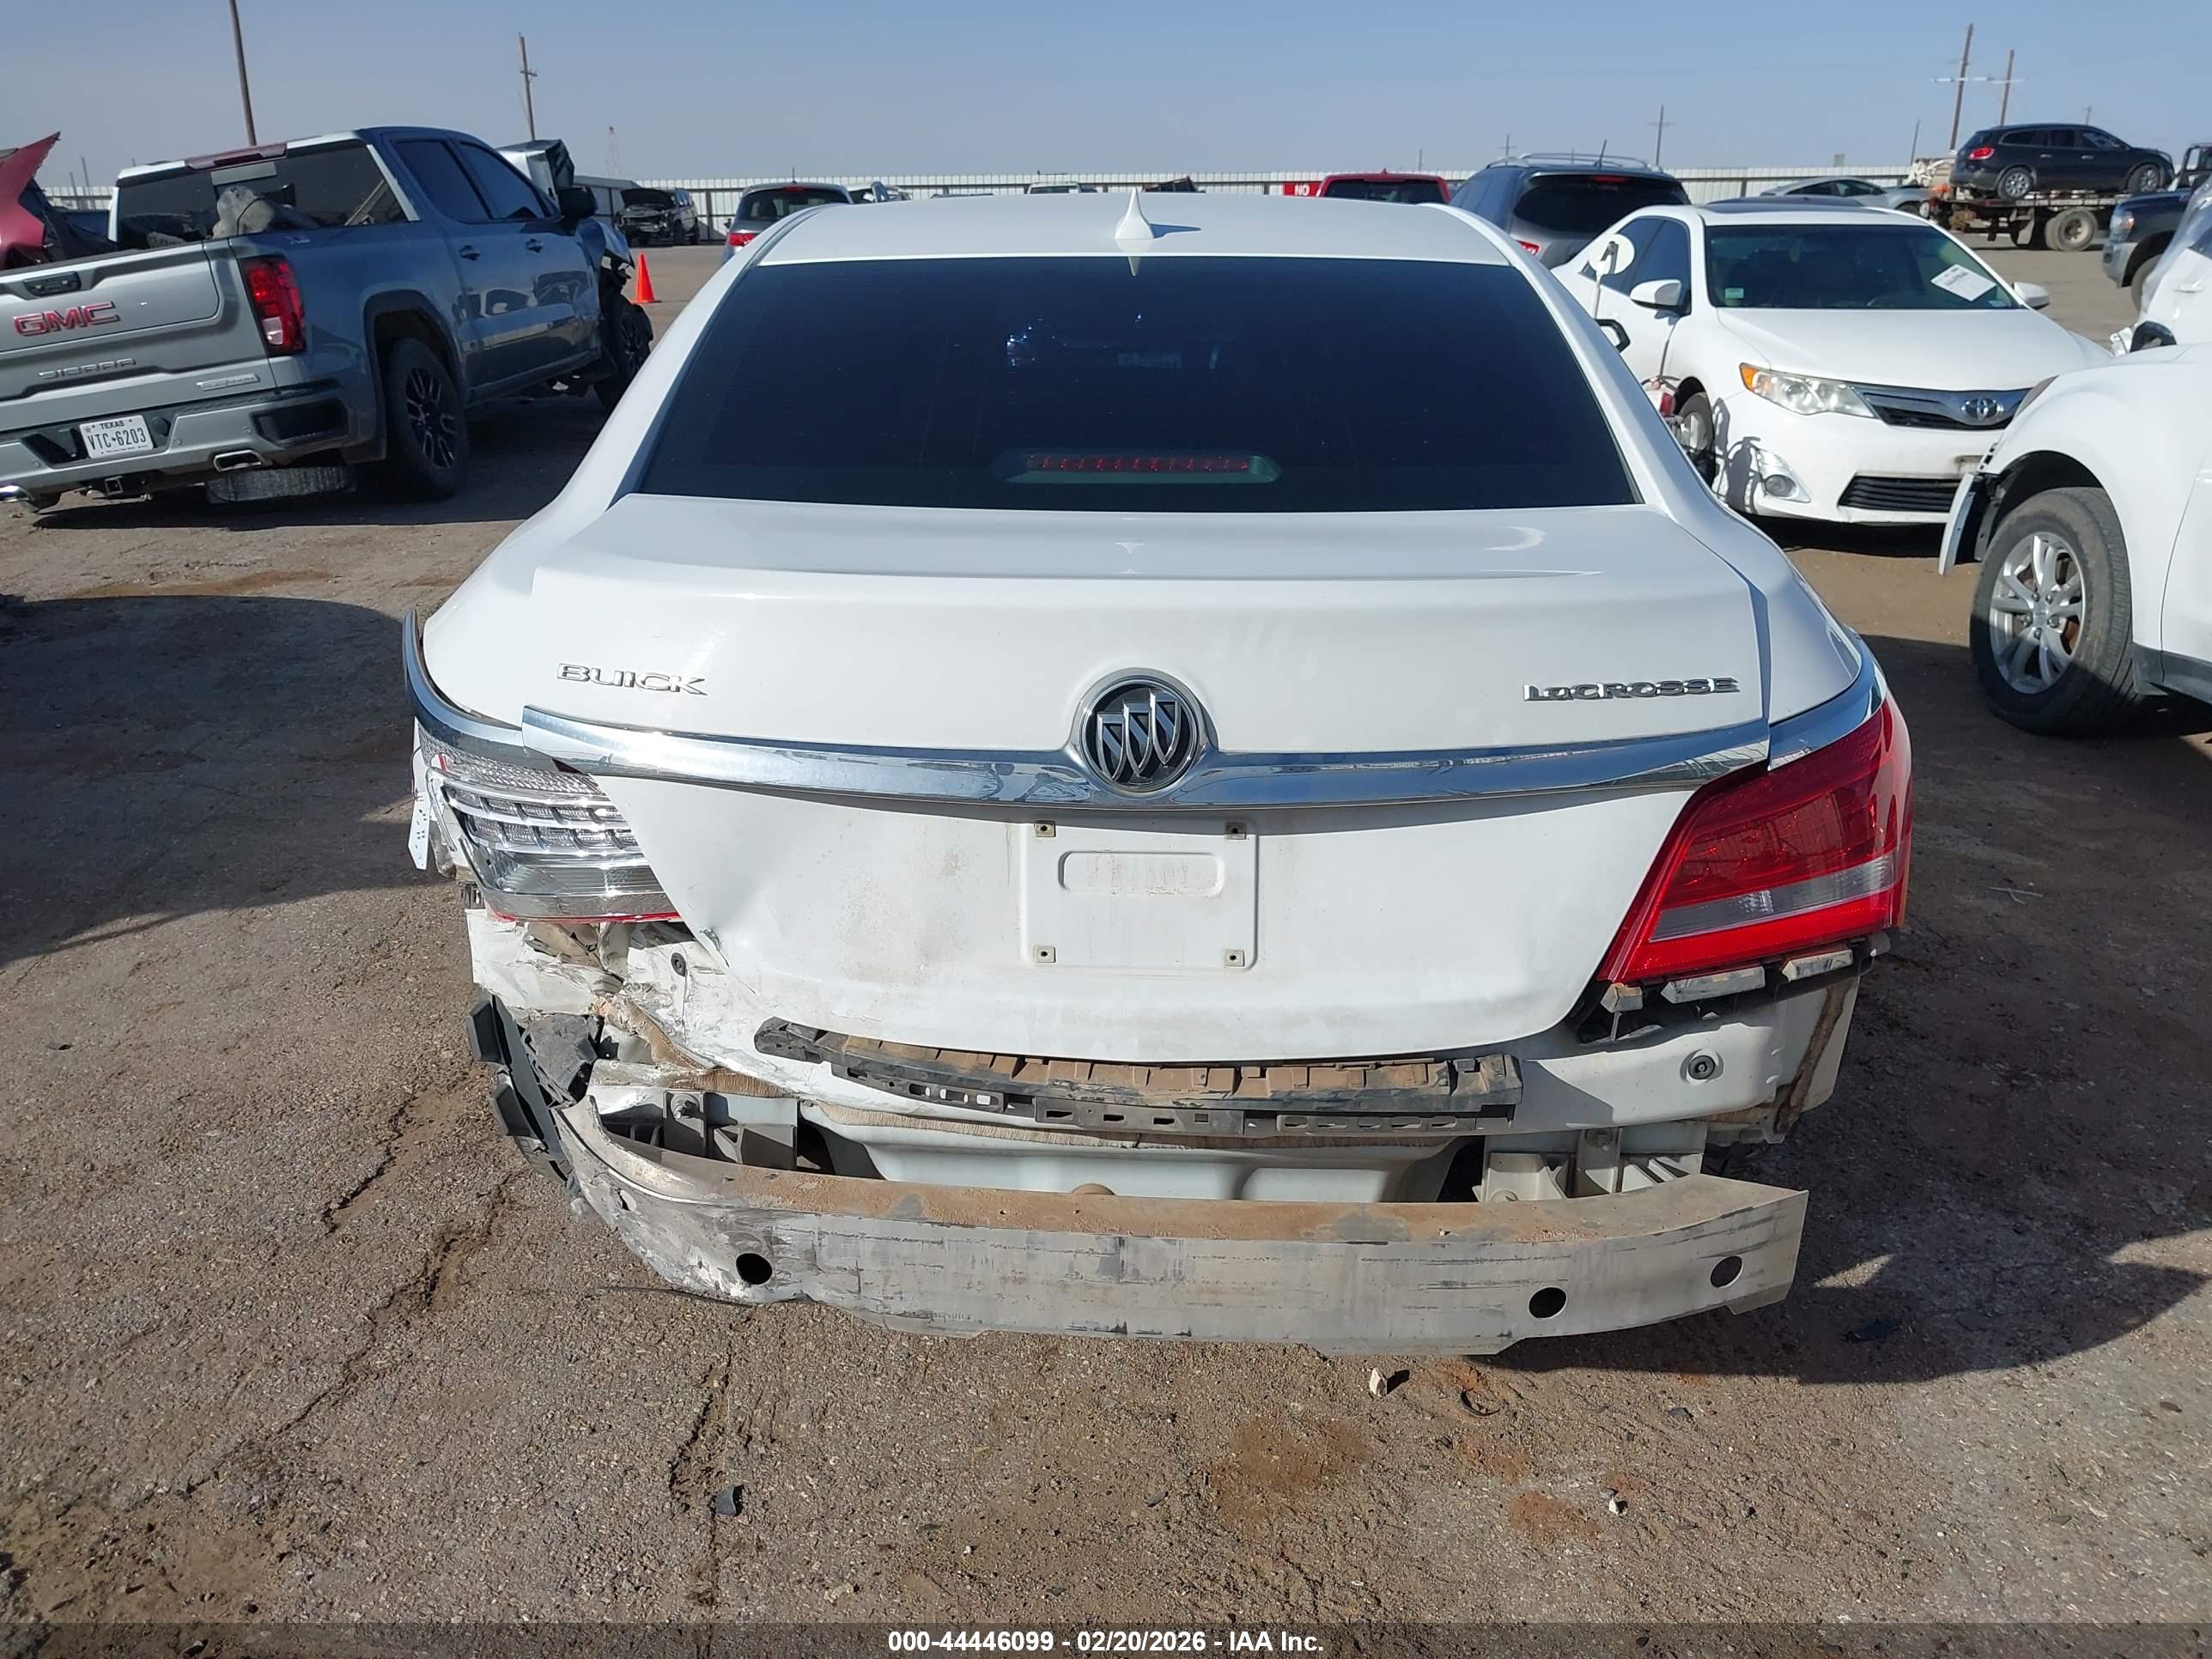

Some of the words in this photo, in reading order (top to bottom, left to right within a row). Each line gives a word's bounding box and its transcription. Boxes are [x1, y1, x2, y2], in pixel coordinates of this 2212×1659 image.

[1294, 183, 1310, 197] NO
[13, 301, 121, 337] GMC
[38, 357, 137, 379] SIERRA
[100, 420, 125, 430] TEXAS
[556, 663, 708, 696] BUICK
